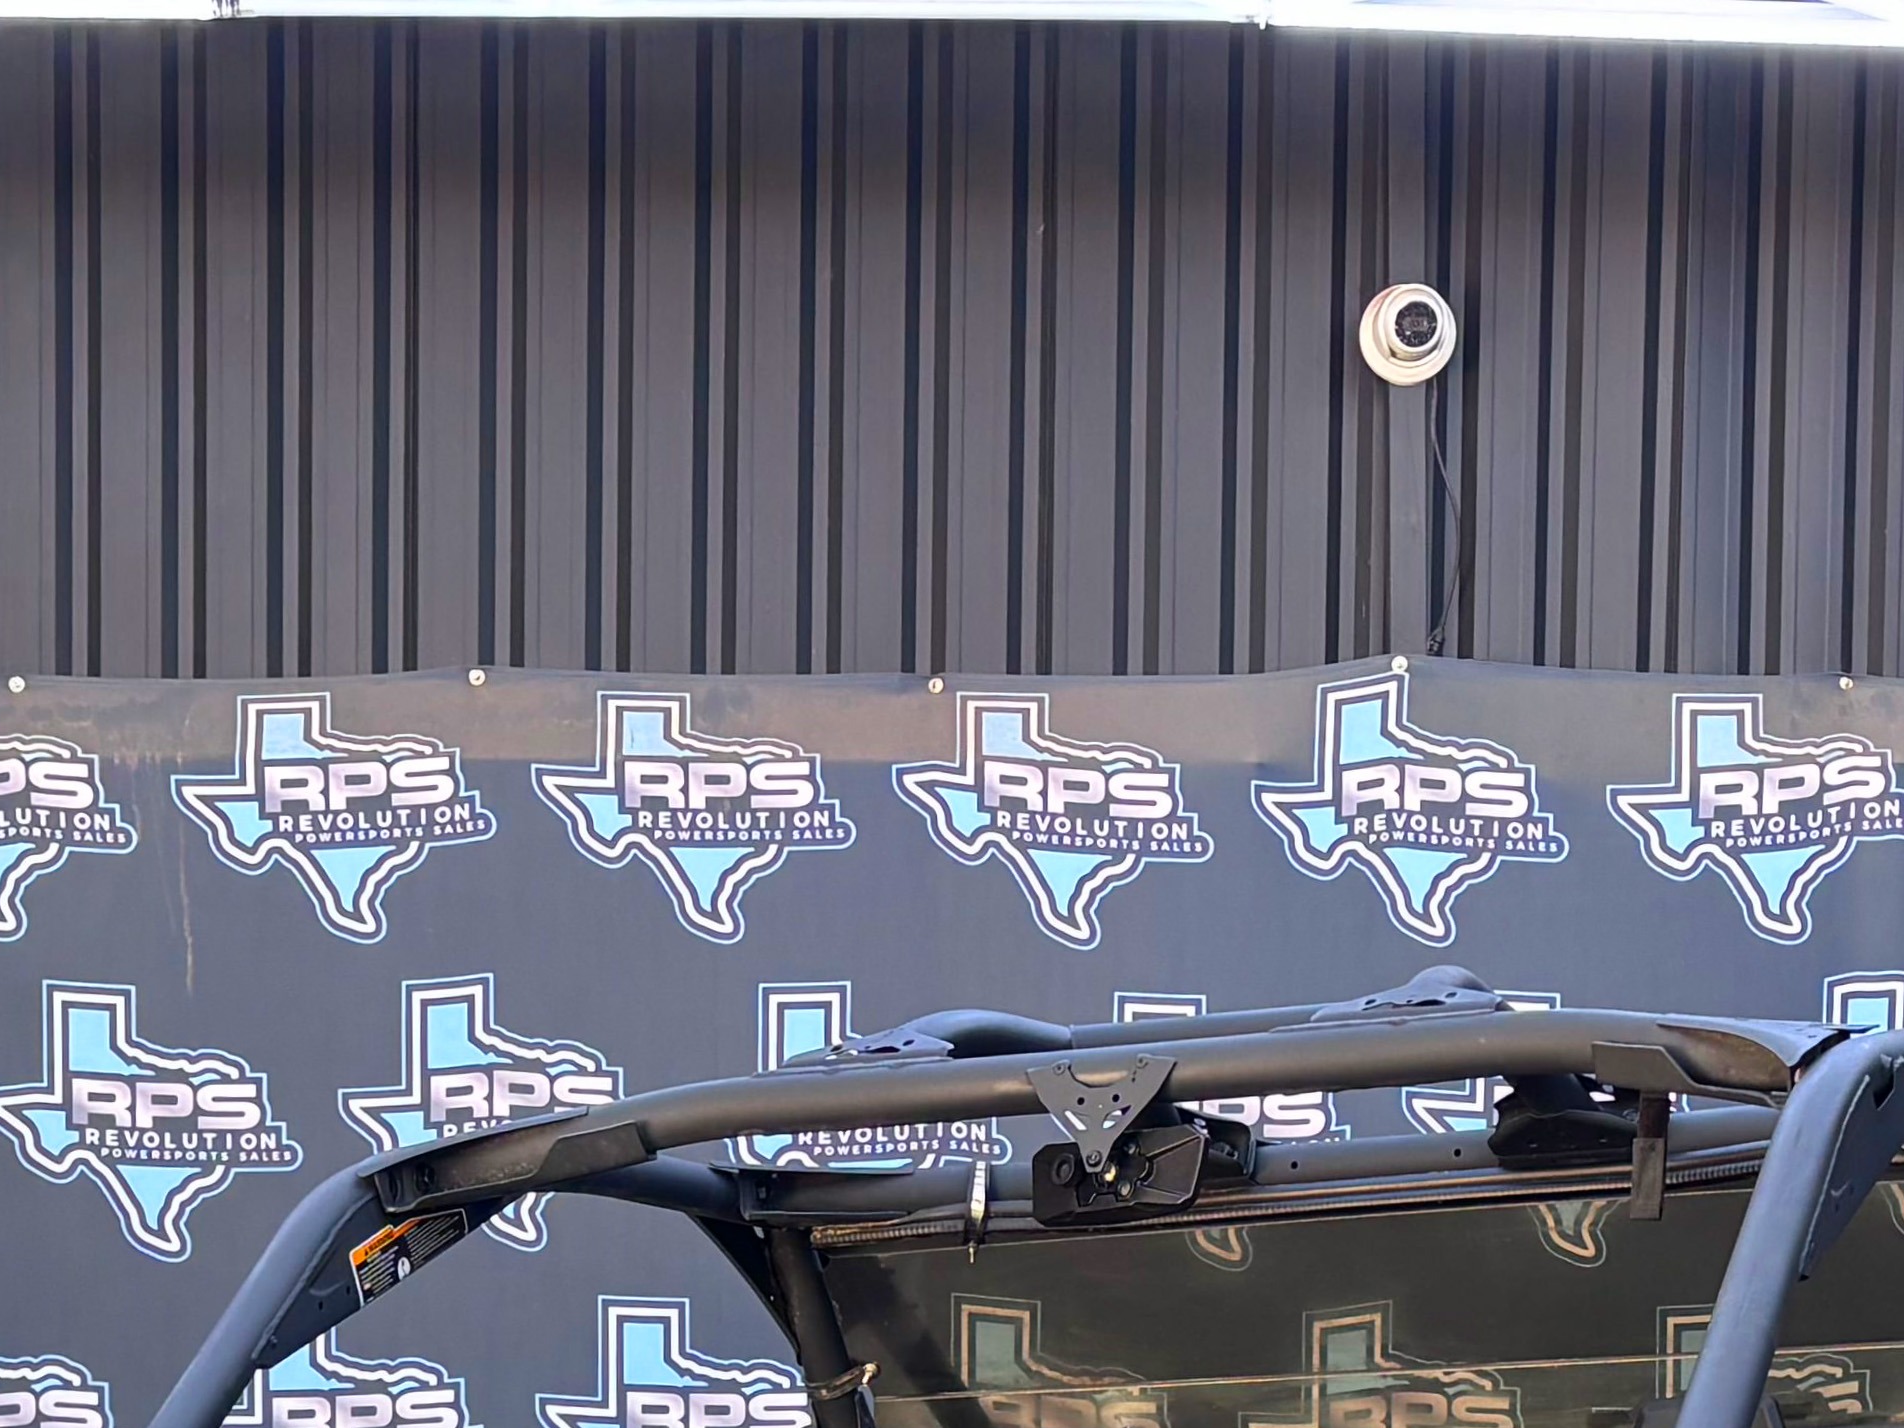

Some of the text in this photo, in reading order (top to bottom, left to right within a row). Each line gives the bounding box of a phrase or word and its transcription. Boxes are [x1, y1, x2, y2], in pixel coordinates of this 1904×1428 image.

[264, 757, 454, 812] RPS
[625, 762, 814, 809] RPS
[984, 761, 1172, 818] RPS
[1342, 764, 1528, 818] RPS
[1698, 755, 1886, 819] RPS
[279, 803, 469, 832] REVOLUTION
[295, 820, 484, 842] POWERSPORTS SALES
[638, 811, 828, 829] REVOLUTION
[998, 811, 1187, 840] REVOLUTION
[1352, 812, 1542, 840] REVOLUTION
[1711, 799, 1901, 838] REVOLUTION
[654, 829, 844, 840] POWERSPORTS SALES
[1012, 831, 1202, 852] POWERSPORTS SALES
[72, 1078, 260, 1129] RPS
[86, 1128, 276, 1150] REVOLUTION
